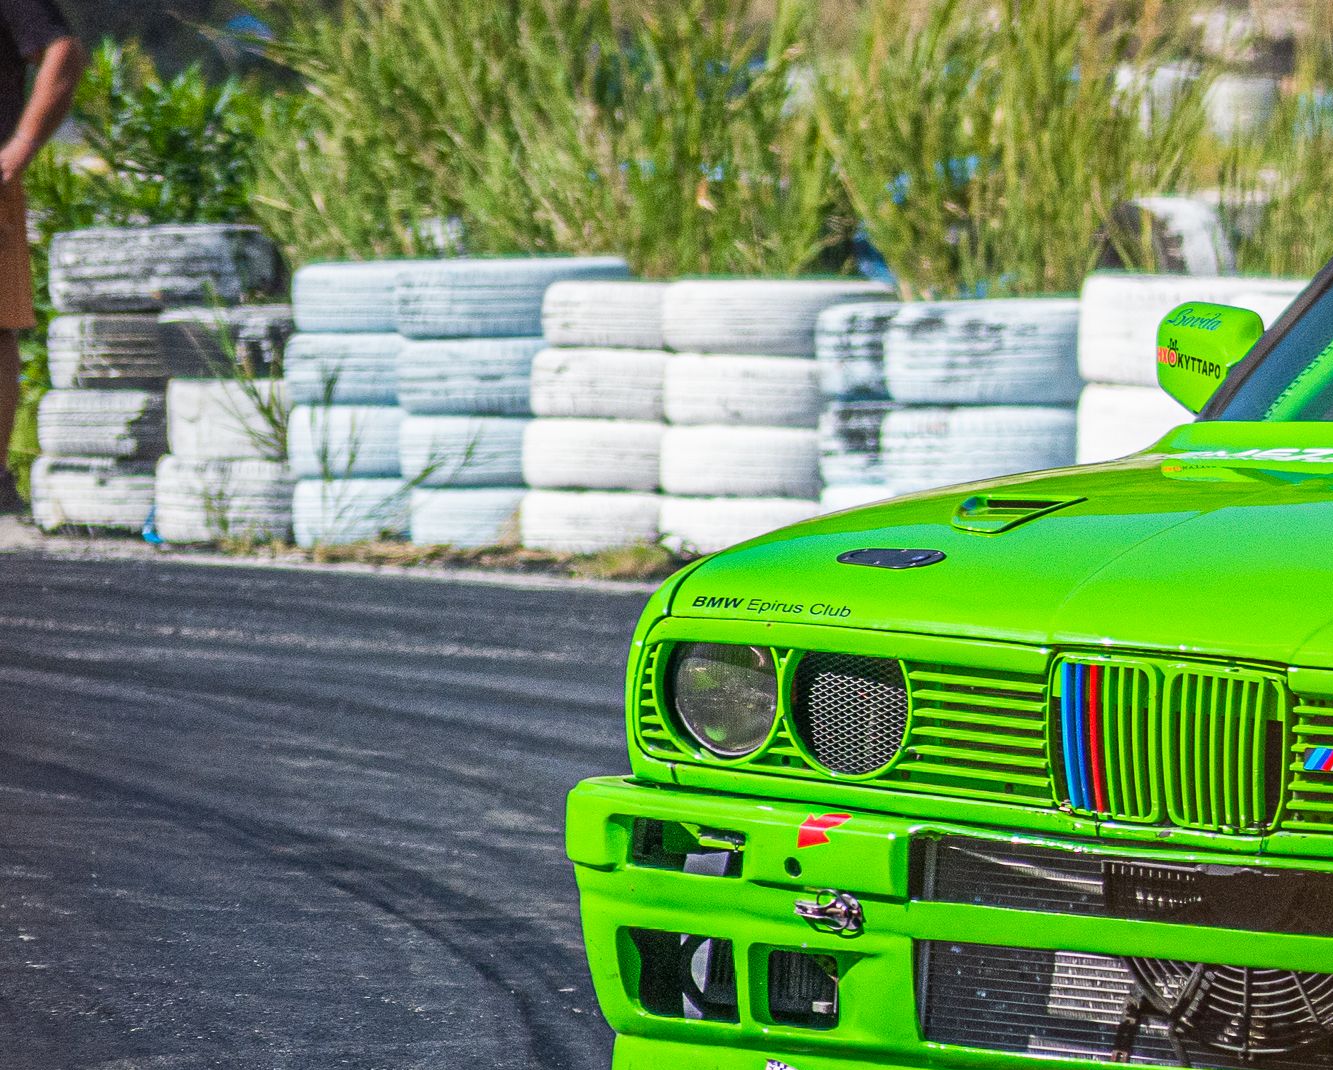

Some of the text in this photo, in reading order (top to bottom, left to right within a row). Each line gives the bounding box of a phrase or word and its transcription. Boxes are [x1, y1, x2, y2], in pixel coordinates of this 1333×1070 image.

[692, 596, 852, 618] BMW Epirus Club
